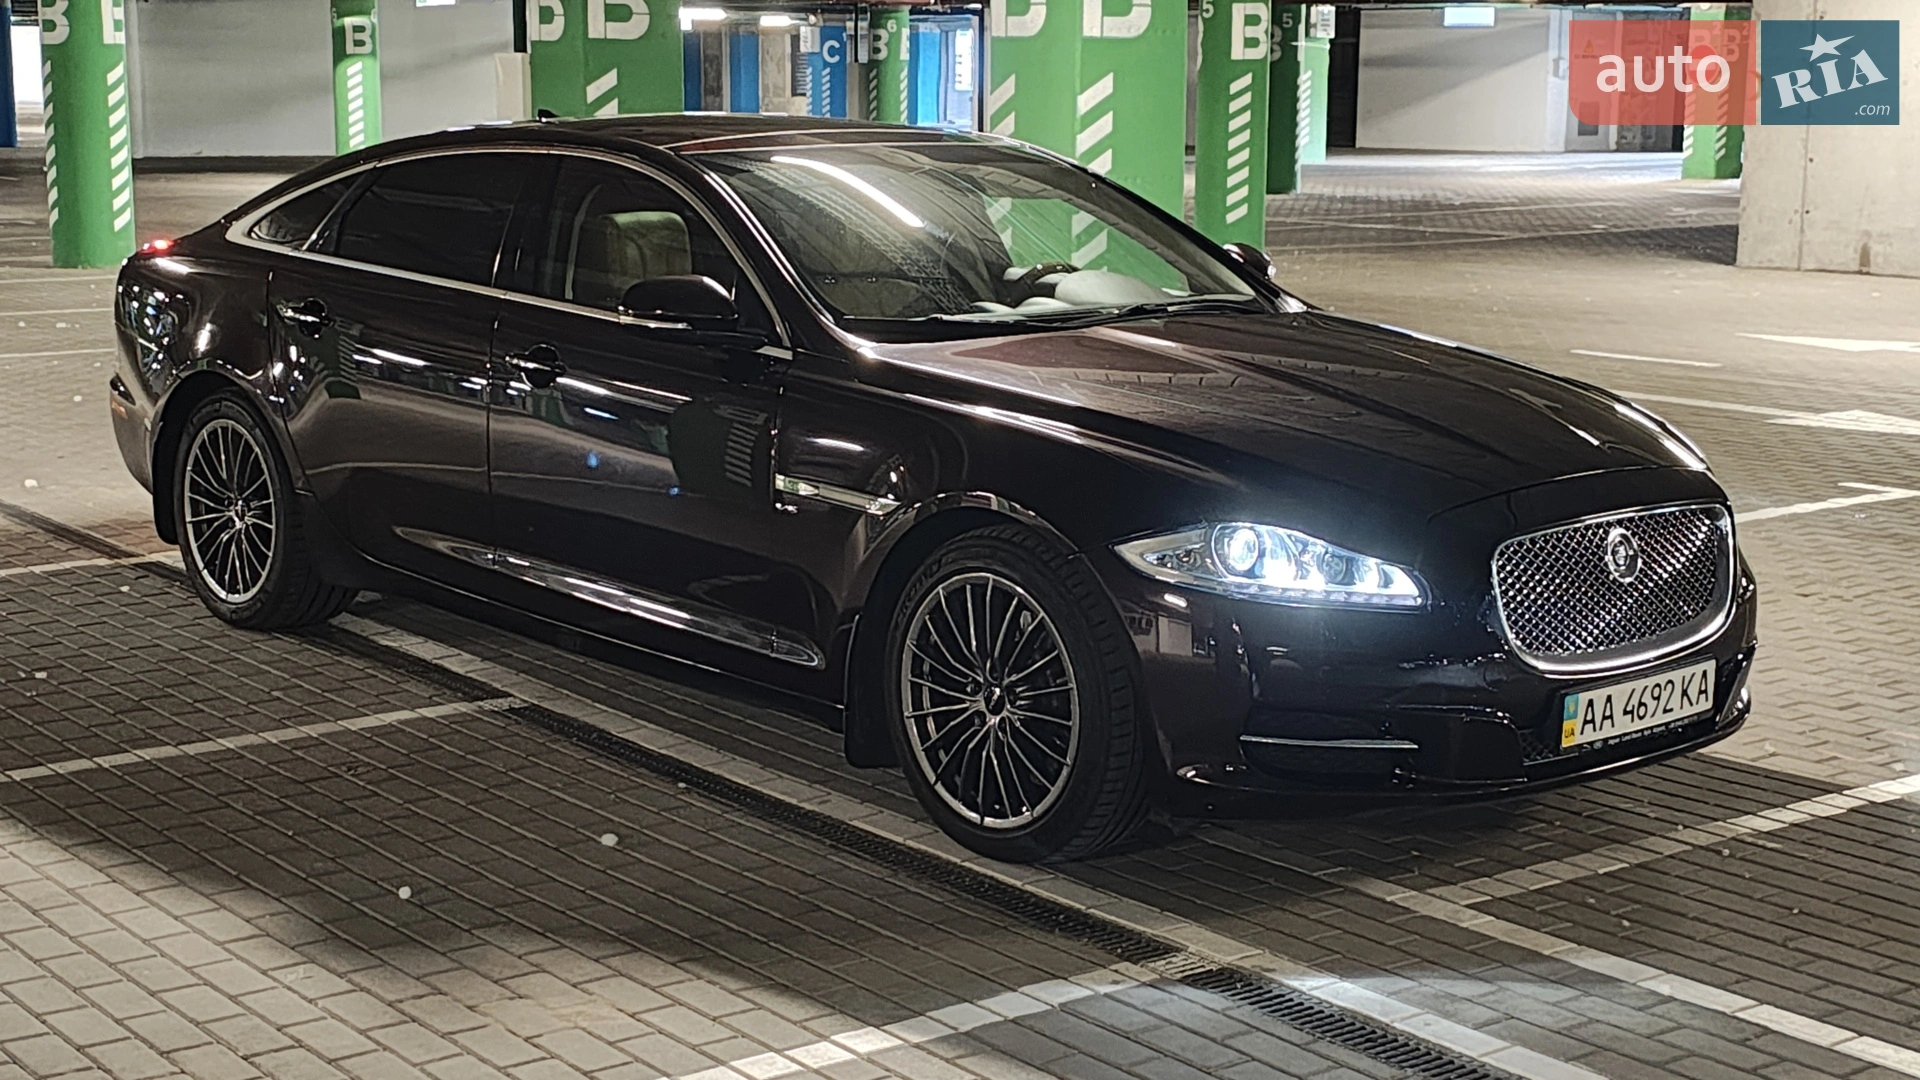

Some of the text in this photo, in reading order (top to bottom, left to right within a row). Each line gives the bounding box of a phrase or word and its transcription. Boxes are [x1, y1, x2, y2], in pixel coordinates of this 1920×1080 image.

[1231, 2, 1268, 60] B
[1580, 669, 1709, 736] AA 4692 KA
[1563, 728, 1576, 739] UA
